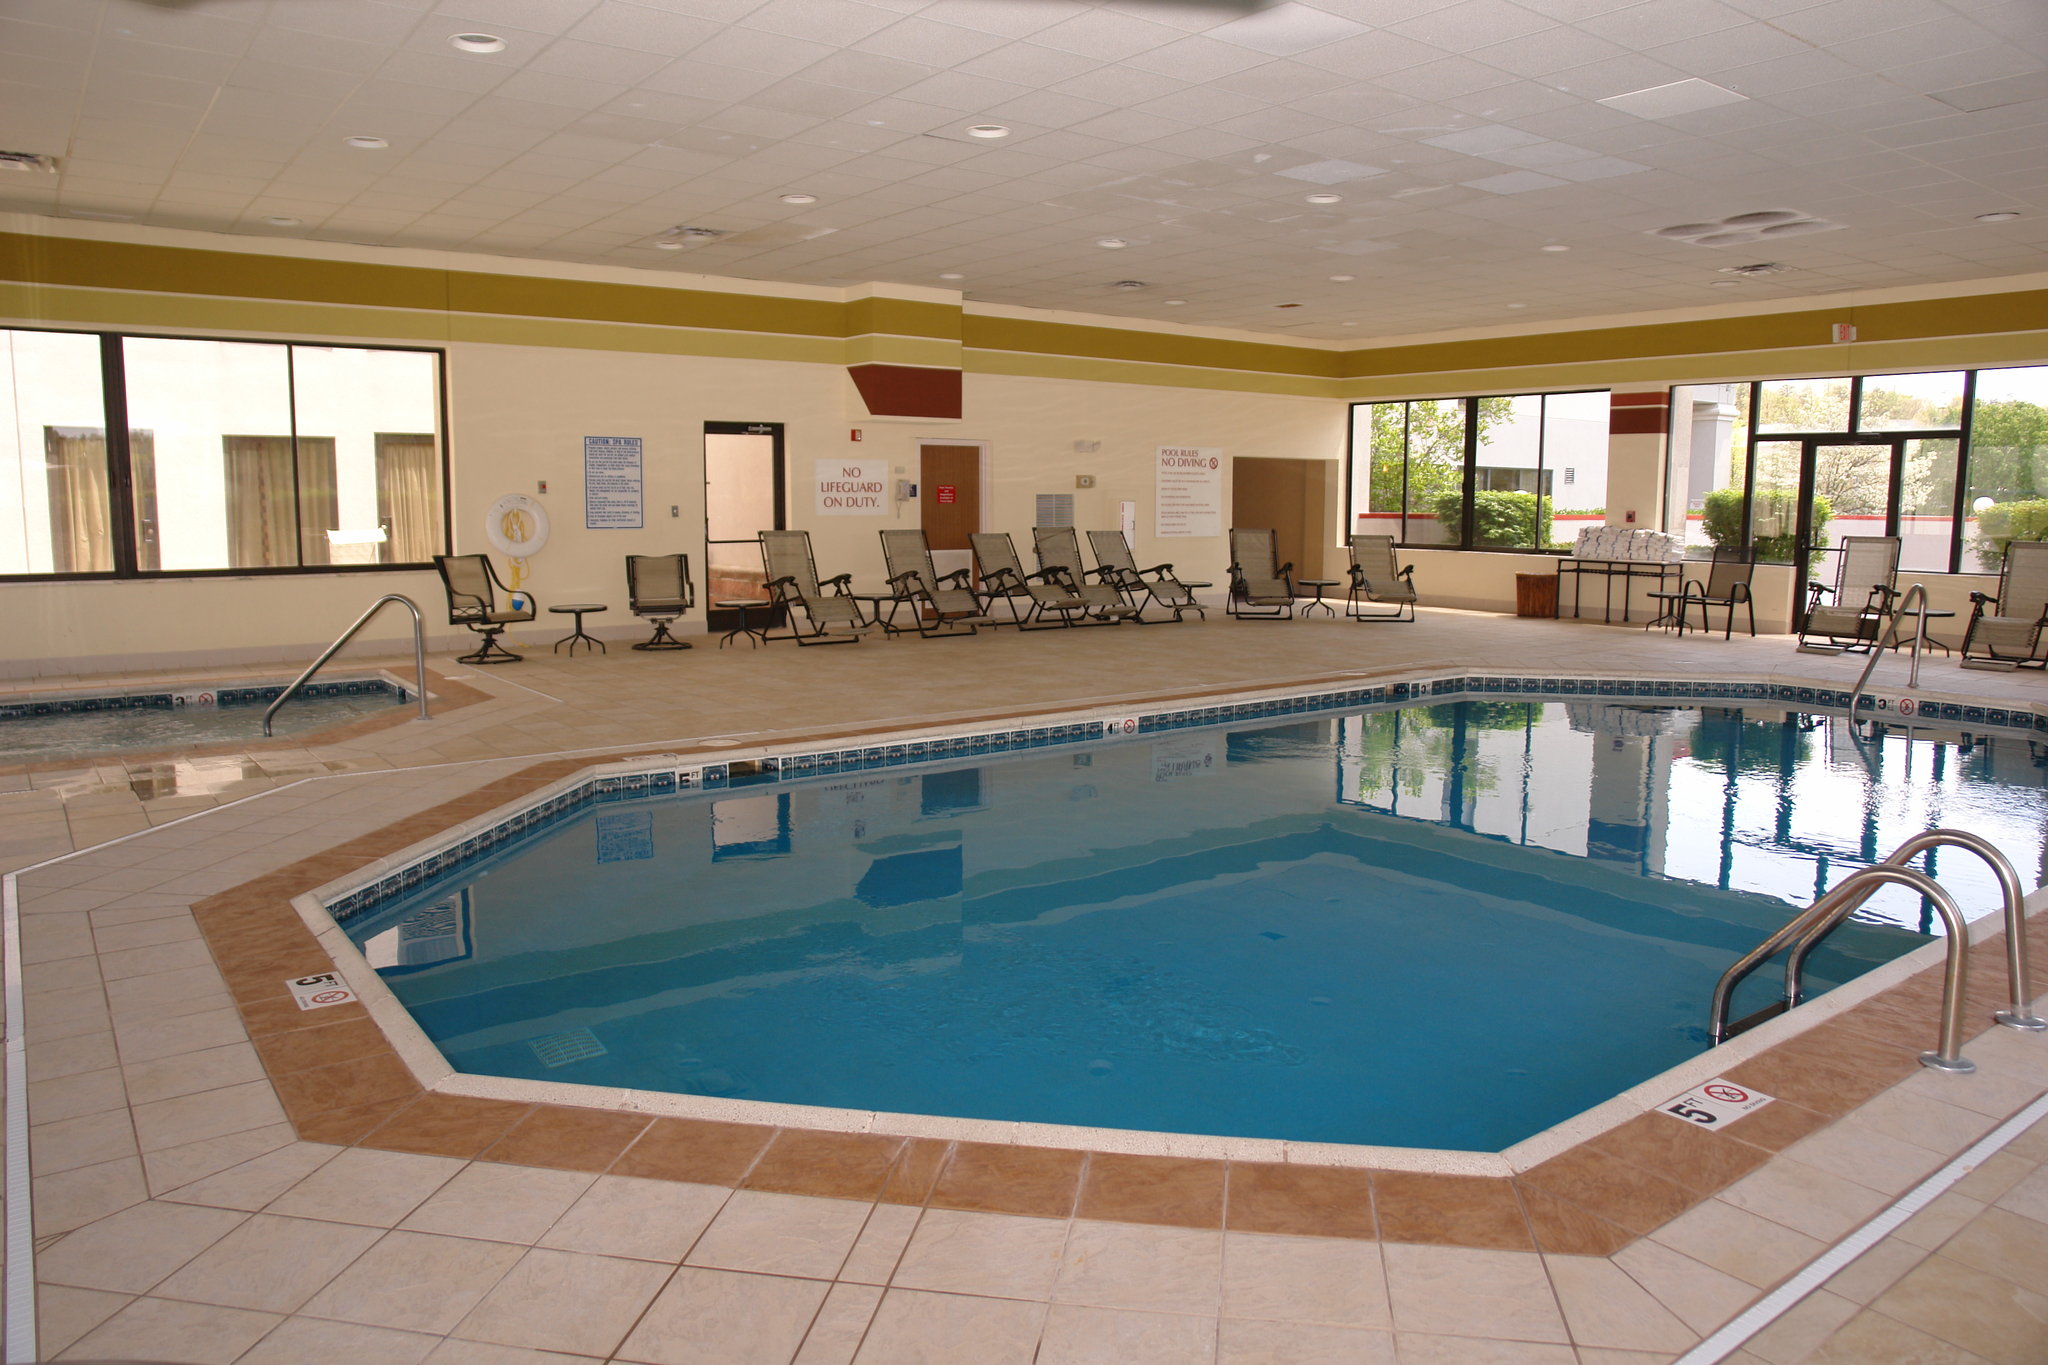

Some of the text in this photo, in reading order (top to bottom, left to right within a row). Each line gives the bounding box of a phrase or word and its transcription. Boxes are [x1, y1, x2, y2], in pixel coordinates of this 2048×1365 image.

[1839, 324, 1852, 341] EXIT
[1180, 449, 1199, 457] RULES
[1161, 457, 1207, 468] NO DIVING
[842, 466, 861, 478] NO
[820, 481, 883, 493] LIFEGUARD
[823, 496, 880, 507] ON DUTY.
[691, 771, 700, 779] FT
[296, 974, 335, 986] 5
[1667, 1097, 1717, 1124] 5 FT
